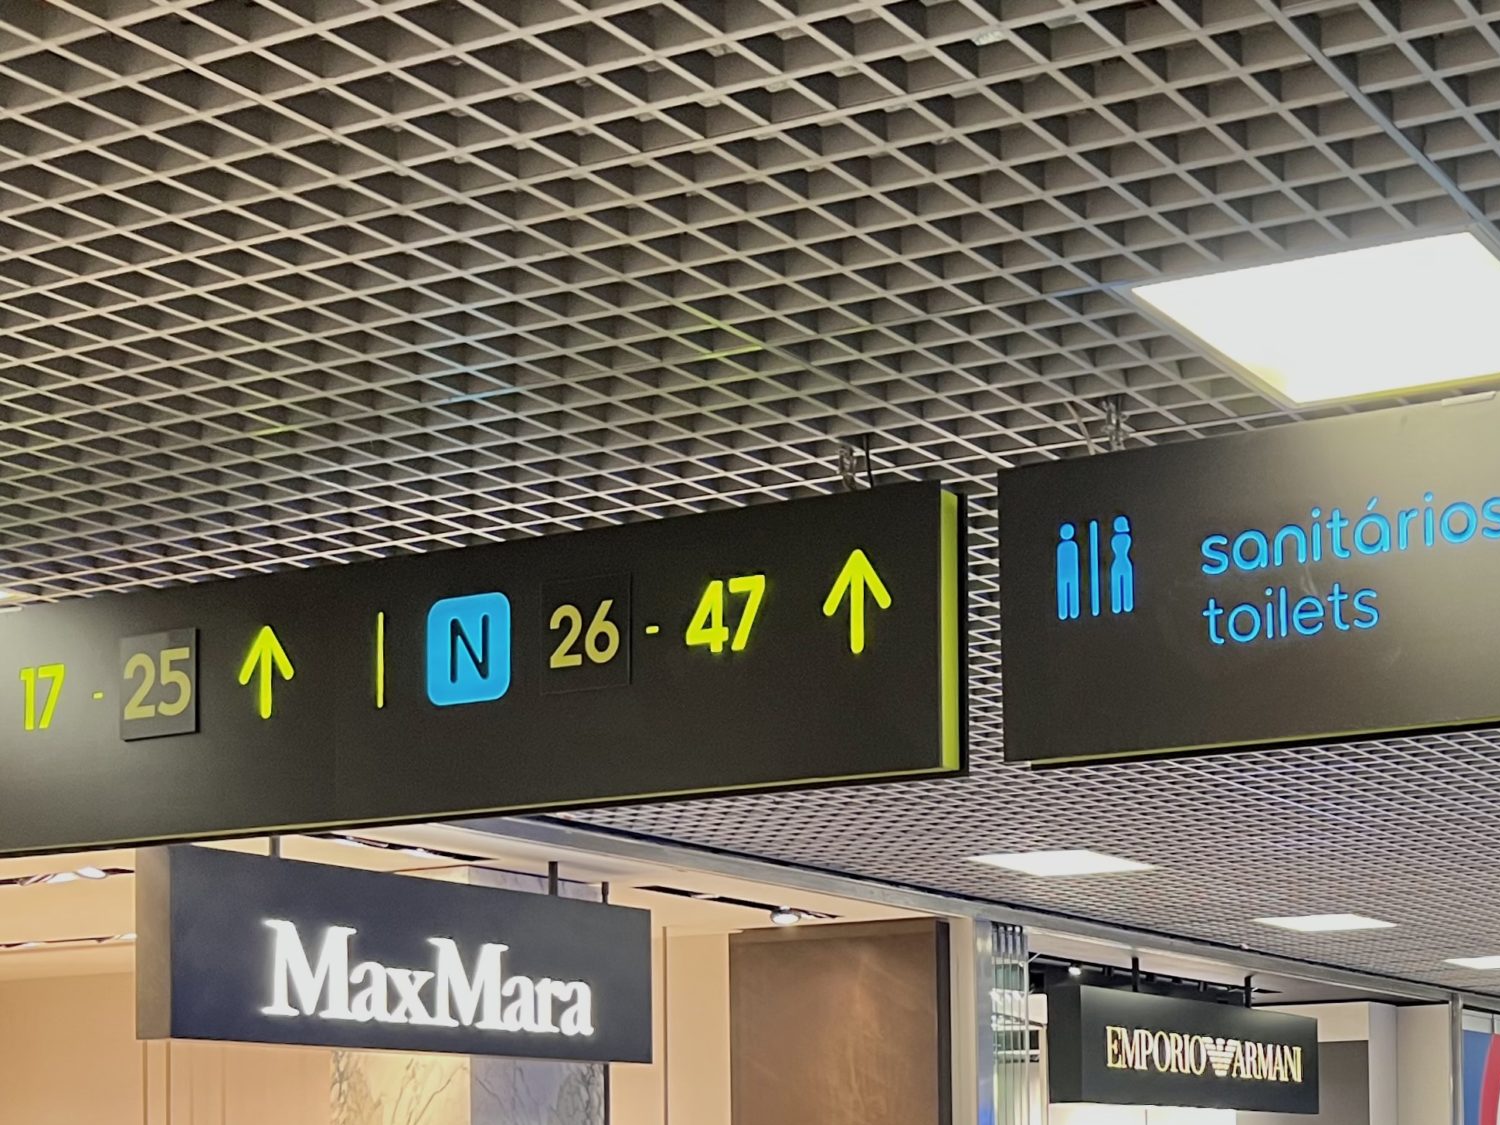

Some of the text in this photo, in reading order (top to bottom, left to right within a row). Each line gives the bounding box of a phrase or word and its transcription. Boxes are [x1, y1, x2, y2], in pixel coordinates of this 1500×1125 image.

[448, 612, 489, 683] N
[549, 600, 620, 668] 26
[685, 575, 766, 653] 47
[1203, 582, 1380, 645] toilets
[19, 664, 64, 730] 17
[122, 647, 191, 719] 25
[261, 918, 595, 1037] MaxMara
[1106, 1025, 1303, 1082] EMPORIO ARMANI
